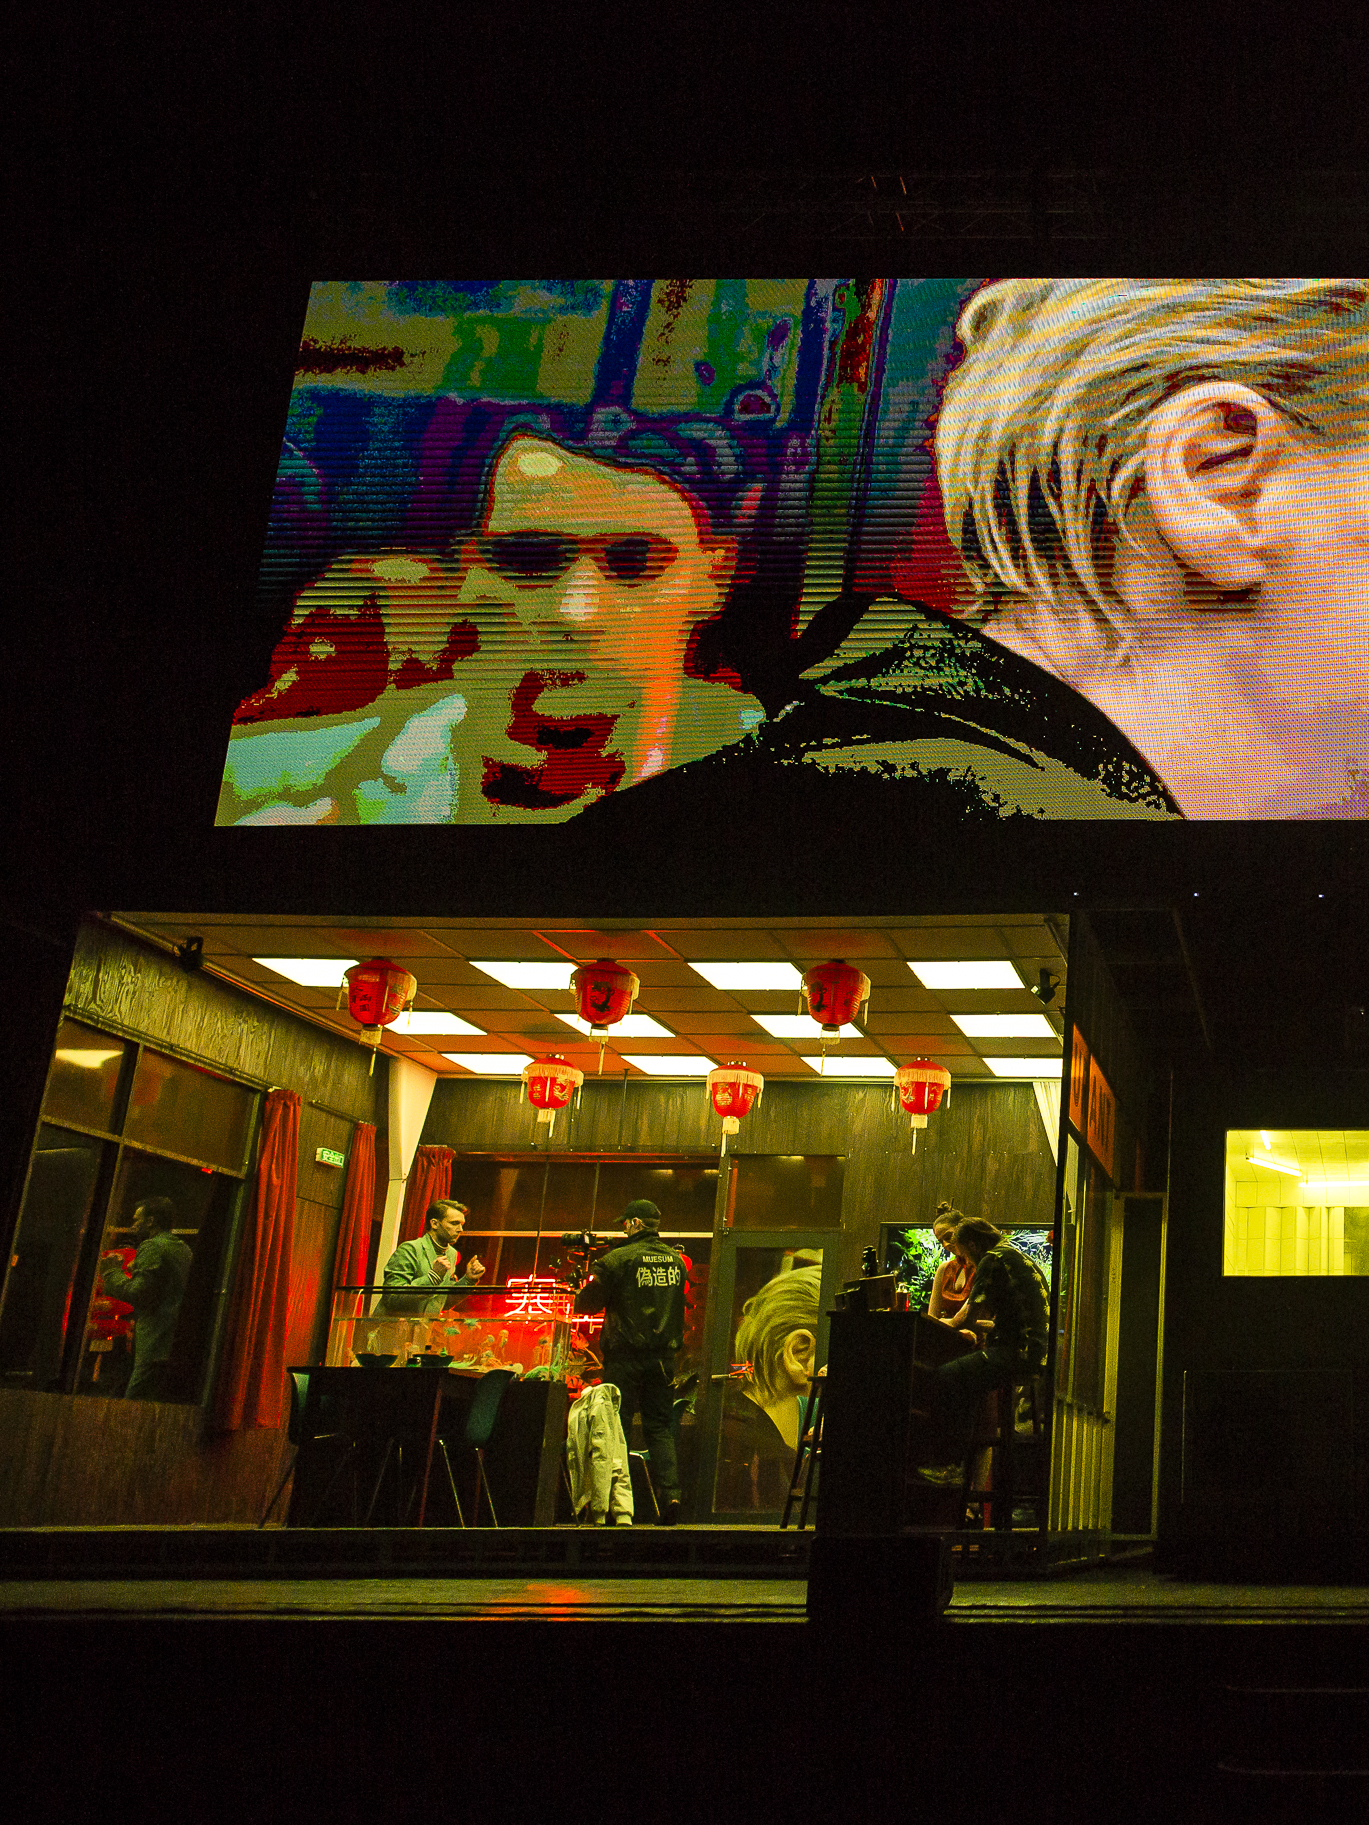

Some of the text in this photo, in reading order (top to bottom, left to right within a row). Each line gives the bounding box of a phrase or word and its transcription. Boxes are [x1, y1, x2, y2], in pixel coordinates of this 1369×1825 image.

[642, 1255, 674, 1263] MUESUM
[635, 1265, 681, 1288] 偽造的
